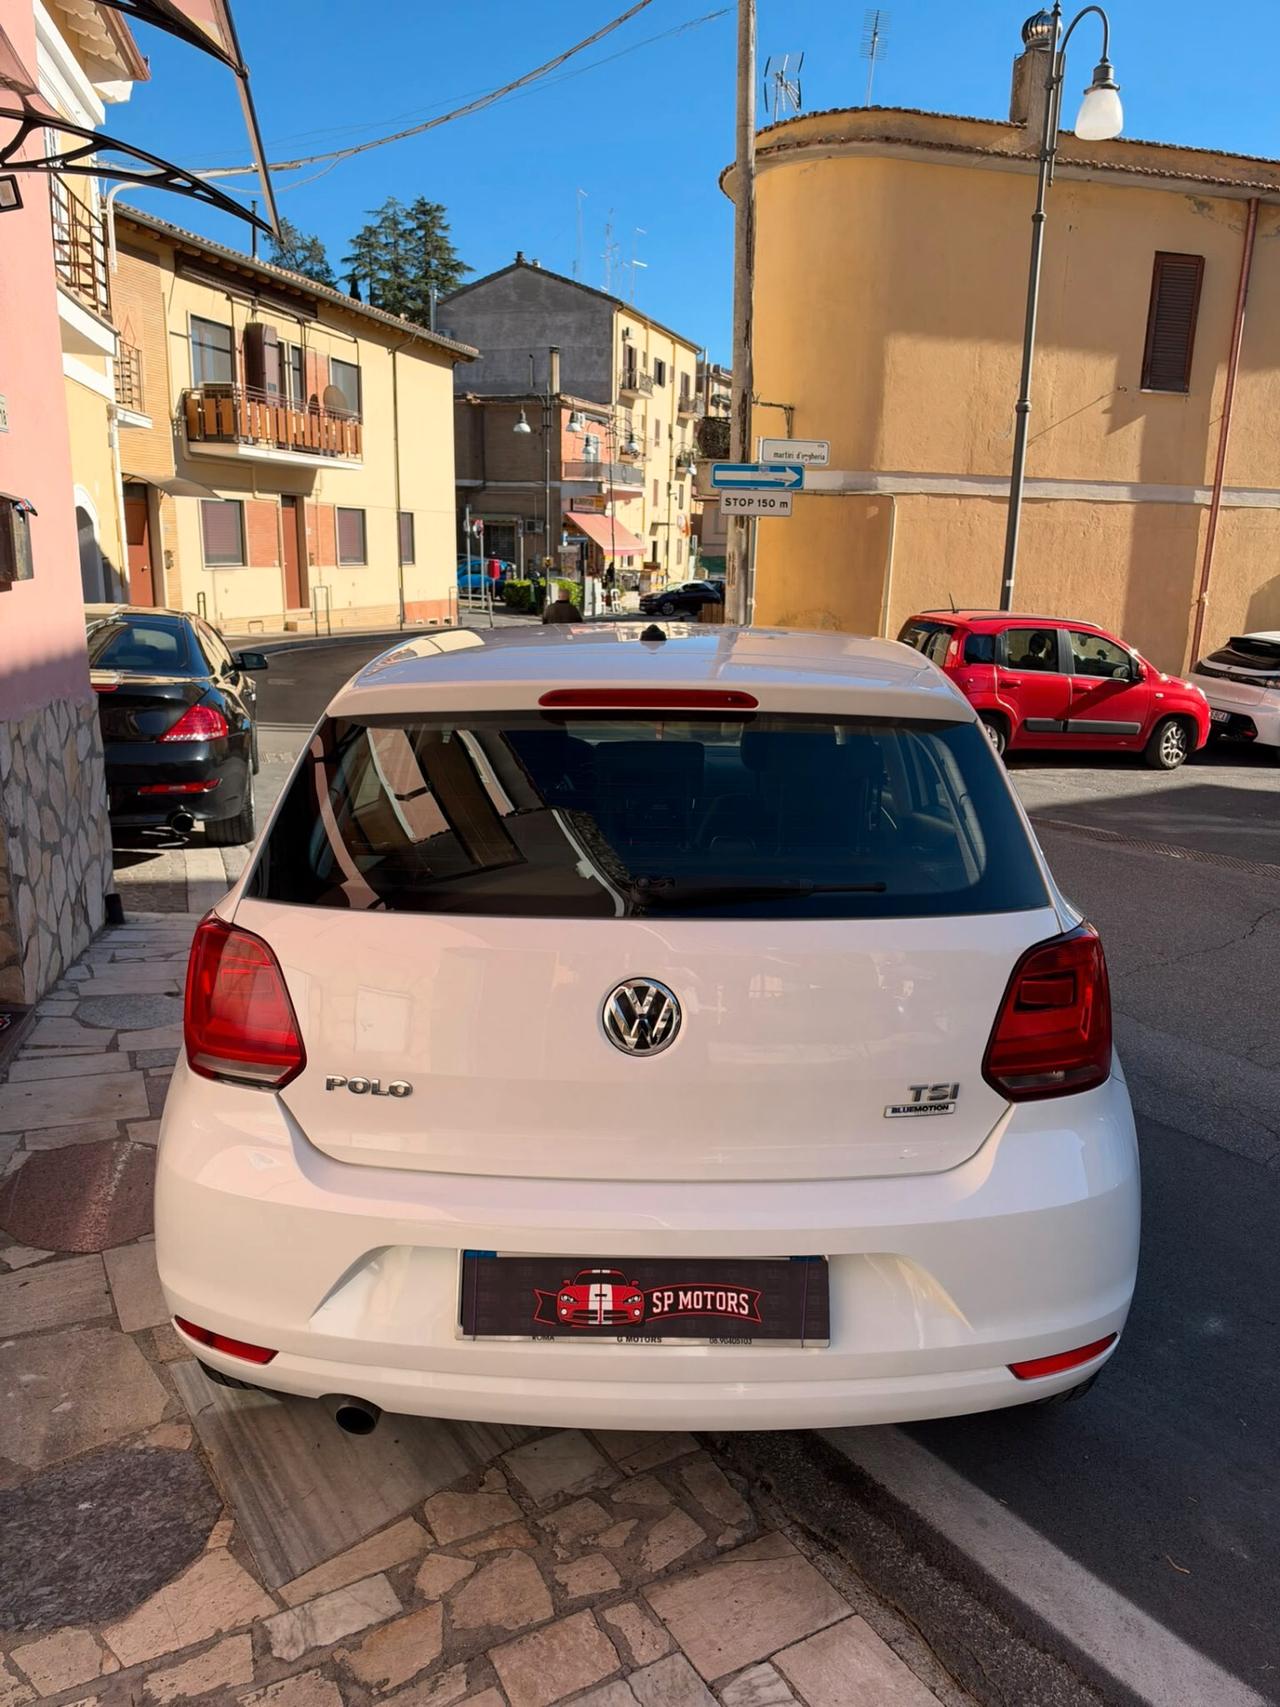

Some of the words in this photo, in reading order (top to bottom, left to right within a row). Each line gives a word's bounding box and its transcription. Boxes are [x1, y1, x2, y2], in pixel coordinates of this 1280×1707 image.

[724, 497, 754, 507] STOP
[757, 498, 776, 508] 150
[779, 501, 789, 509] m
[325, 1074, 414, 1098] POLO
[908, 1082, 960, 1103] TSI
[891, 1104, 949, 1114] BLUEMOTION
[652, 1290, 674, 1314] SP
[678, 1290, 750, 1315] MOTORS
[625, 1336, 662, 1344] MOTORS
